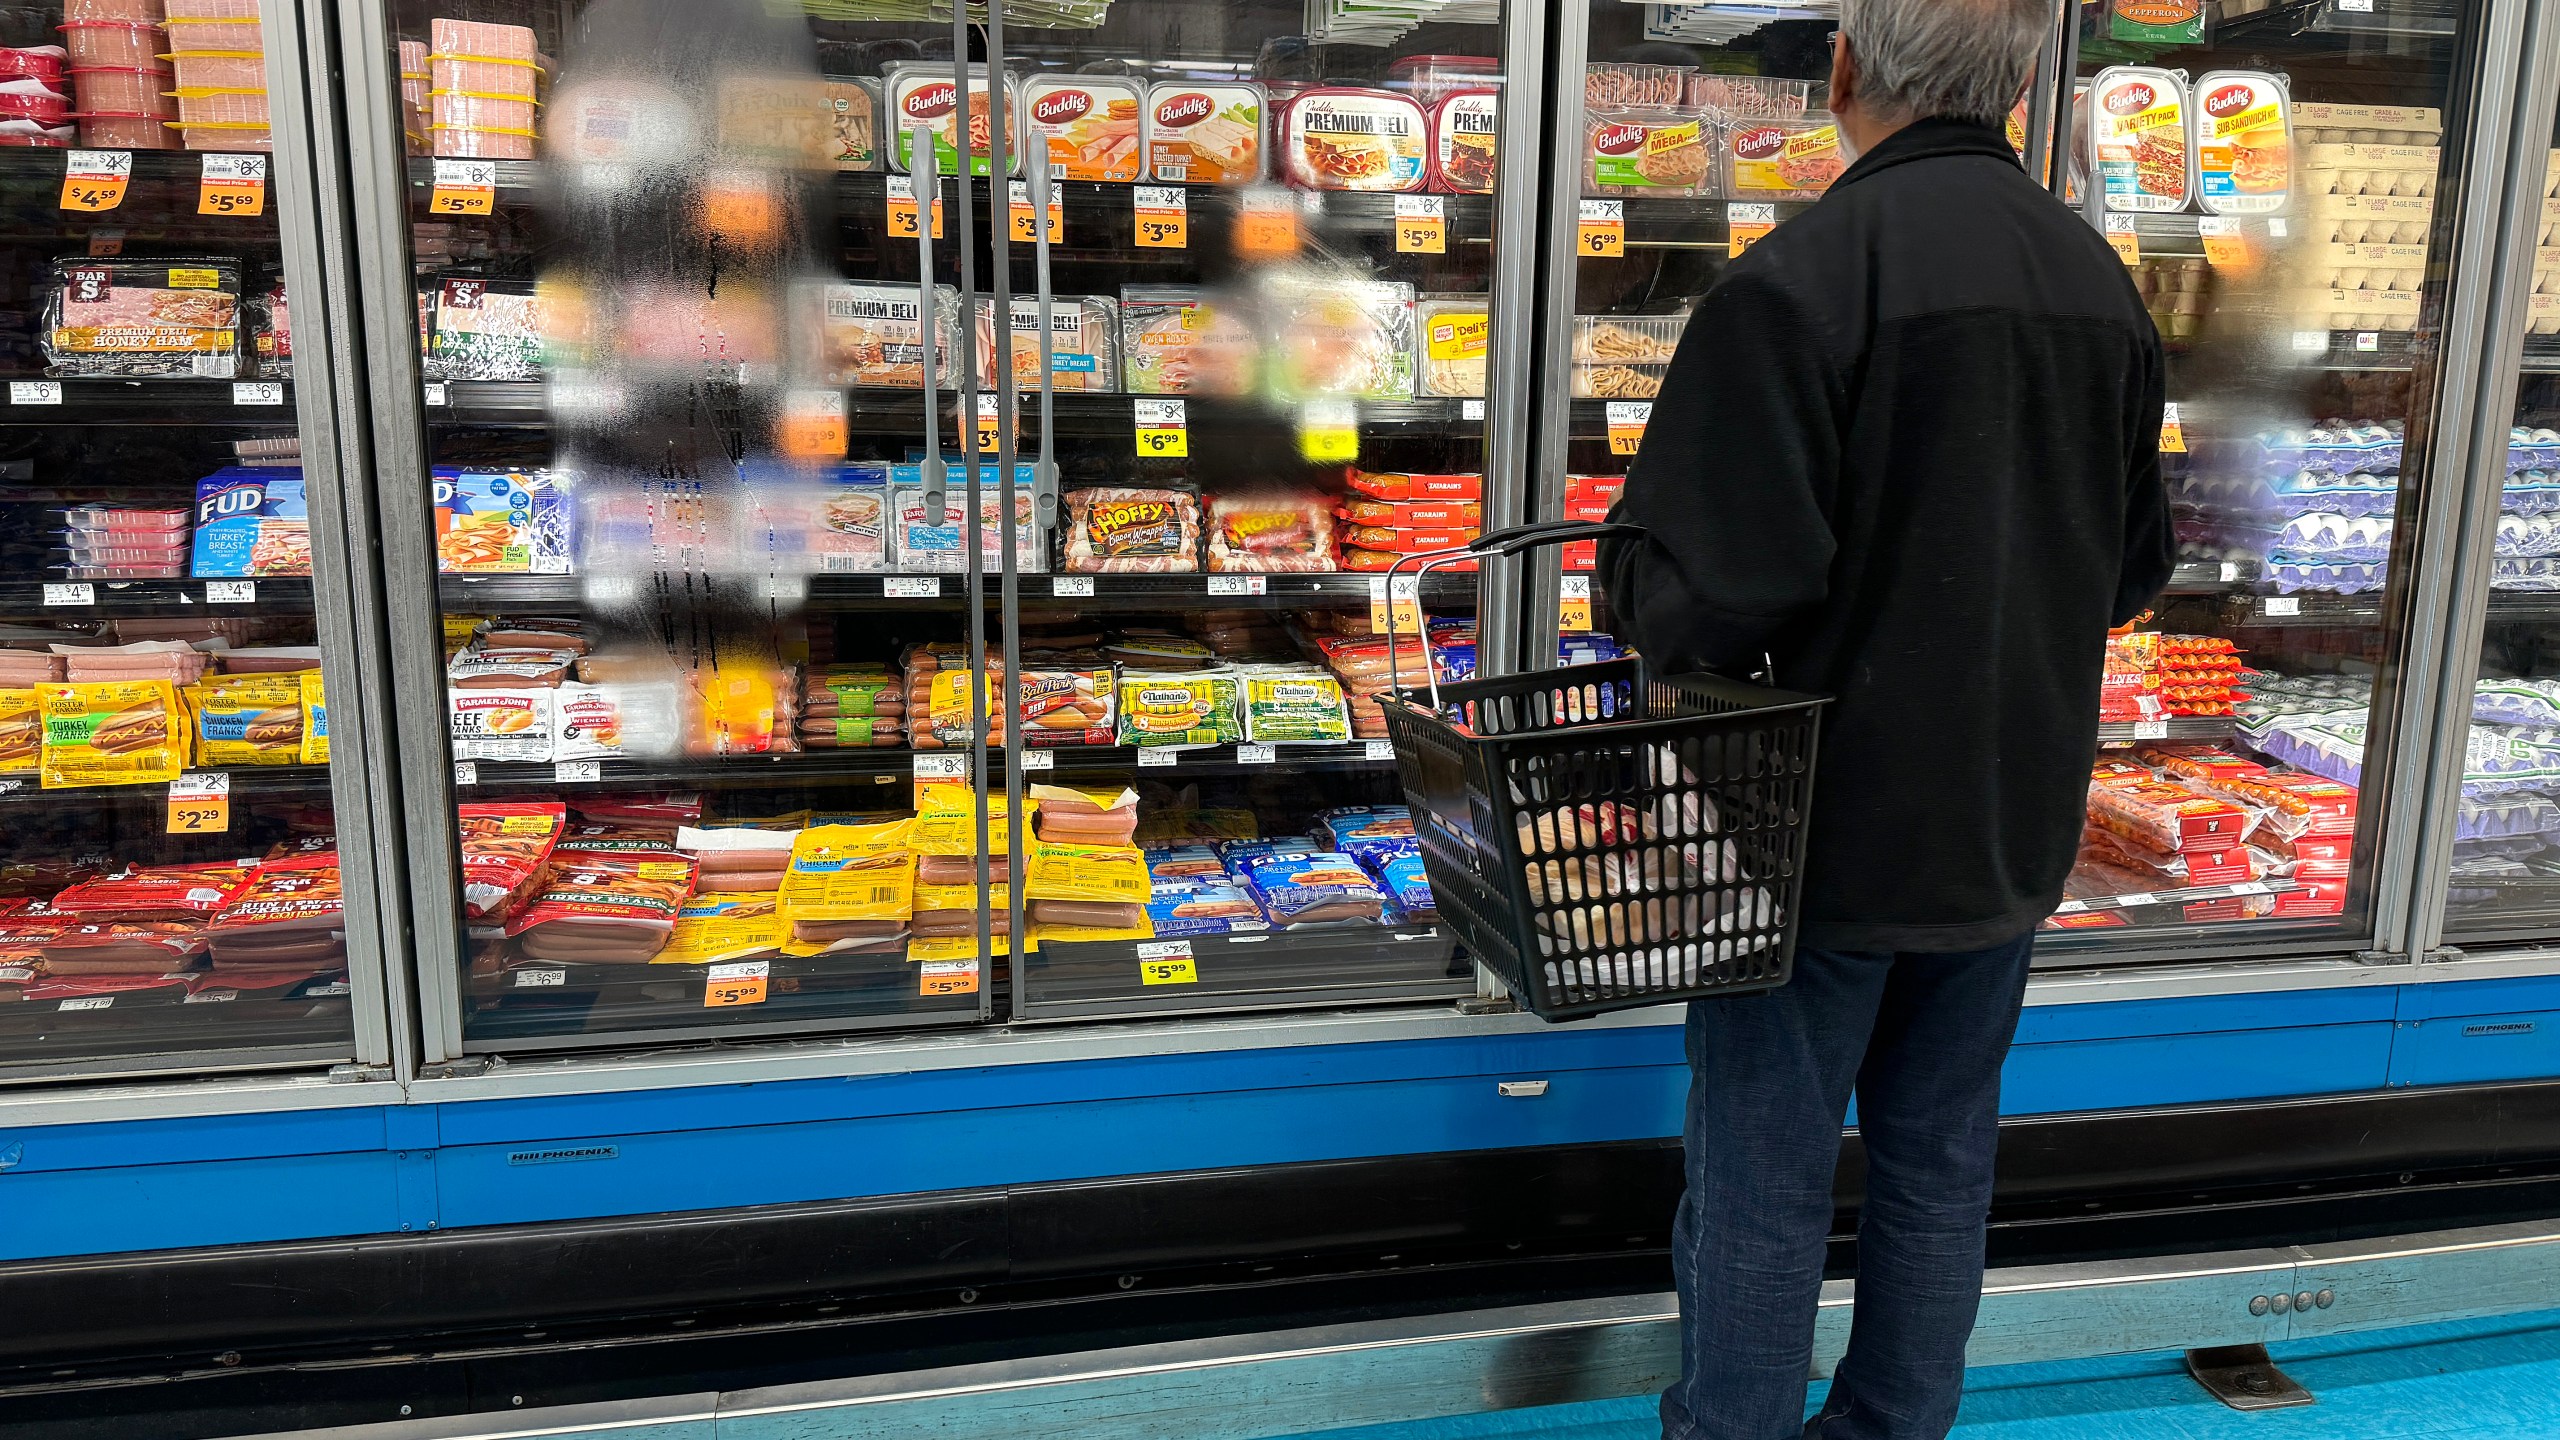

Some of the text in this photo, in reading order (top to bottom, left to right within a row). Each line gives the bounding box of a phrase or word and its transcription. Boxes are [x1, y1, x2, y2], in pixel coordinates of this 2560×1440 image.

[2128, 8, 2184, 18] PEPPERONI
[909, 88, 957, 112] Buddig
[2109, 88, 2152, 110] Buddig
[2209, 89, 2250, 112] Buddig
[1037, 94, 1088, 118] Buddig
[1160, 98, 1209, 121] Buddig
[1455, 99, 1483, 115] Buddig
[1305, 112, 1409, 133] PREMIUM DELI
[2116, 110, 2176, 132] VARIETY PACK
[2217, 110, 2276, 134] SUB SANDWICH KIT
[1599, 126, 1644, 149] Buddig
[1651, 134, 1684, 151] MEGA
[1738, 129, 1782, 152] Buddig
[1154, 145, 1169, 155] HONEY
[1154, 154, 1192, 163] ROASTED TURKEY
[1598, 164, 1616, 173] TURKEY
[67, 174, 114, 183] Reduced Price
[202, 179, 248, 188] Reduced Price
[1136, 208, 1158, 216] Reduced
[75, 271, 106, 282] BAR
[79, 281, 100, 300] S
[454, 289, 474, 305] S
[828, 301, 918, 319] PREMIUM DELI
[1053, 315, 1079, 331] DELI
[99, 328, 188, 337] PREMIUM DELI
[1457, 323, 1478, 336] Deli
[93, 335, 195, 347] HONEY HAM
[2359, 334, 2376, 345] wic
[903, 345, 924, 353] FOREST
[1070, 360, 1090, 368] BREAST
[1429, 482, 1462, 490] ZATARAIN'S
[200, 489, 262, 523] FUD
[1096, 502, 1164, 534] HOFFY
[1232, 512, 1296, 538] HOFFY
[208, 533, 245, 542] TURKEY
[1108, 523, 1169, 547] Bacon Wrapped
[1415, 536, 1449, 544] ZATARAIN'S
[208, 542, 244, 550] BREAST
[2103, 674, 2141, 684] LINKS
[1022, 677, 1073, 699] Ball Park
[1276, 687, 1315, 696] Nathan's
[1143, 691, 1188, 700] Nathan's
[51, 701, 85, 709] FOSTER
[206, 698, 236, 706] FOSTER
[459, 697, 529, 708] FARMER JOHN
[565, 703, 592, 711] FARMER
[1028, 701, 1046, 714] BEEF
[1273, 703, 1280, 711] 8
[52, 720, 88, 732] TURKEY
[205, 715, 243, 726] CHICKEN
[1140, 718, 1149, 728] 8
[51, 730, 90, 741] FRANKS
[207, 726, 243, 736] FRANKS
[2106, 777, 2144, 786] CHEDDAR
[800, 860, 841, 868] CHICKEN
[1251, 853, 1308, 867] FUD
[583, 906, 609, 914] Family
